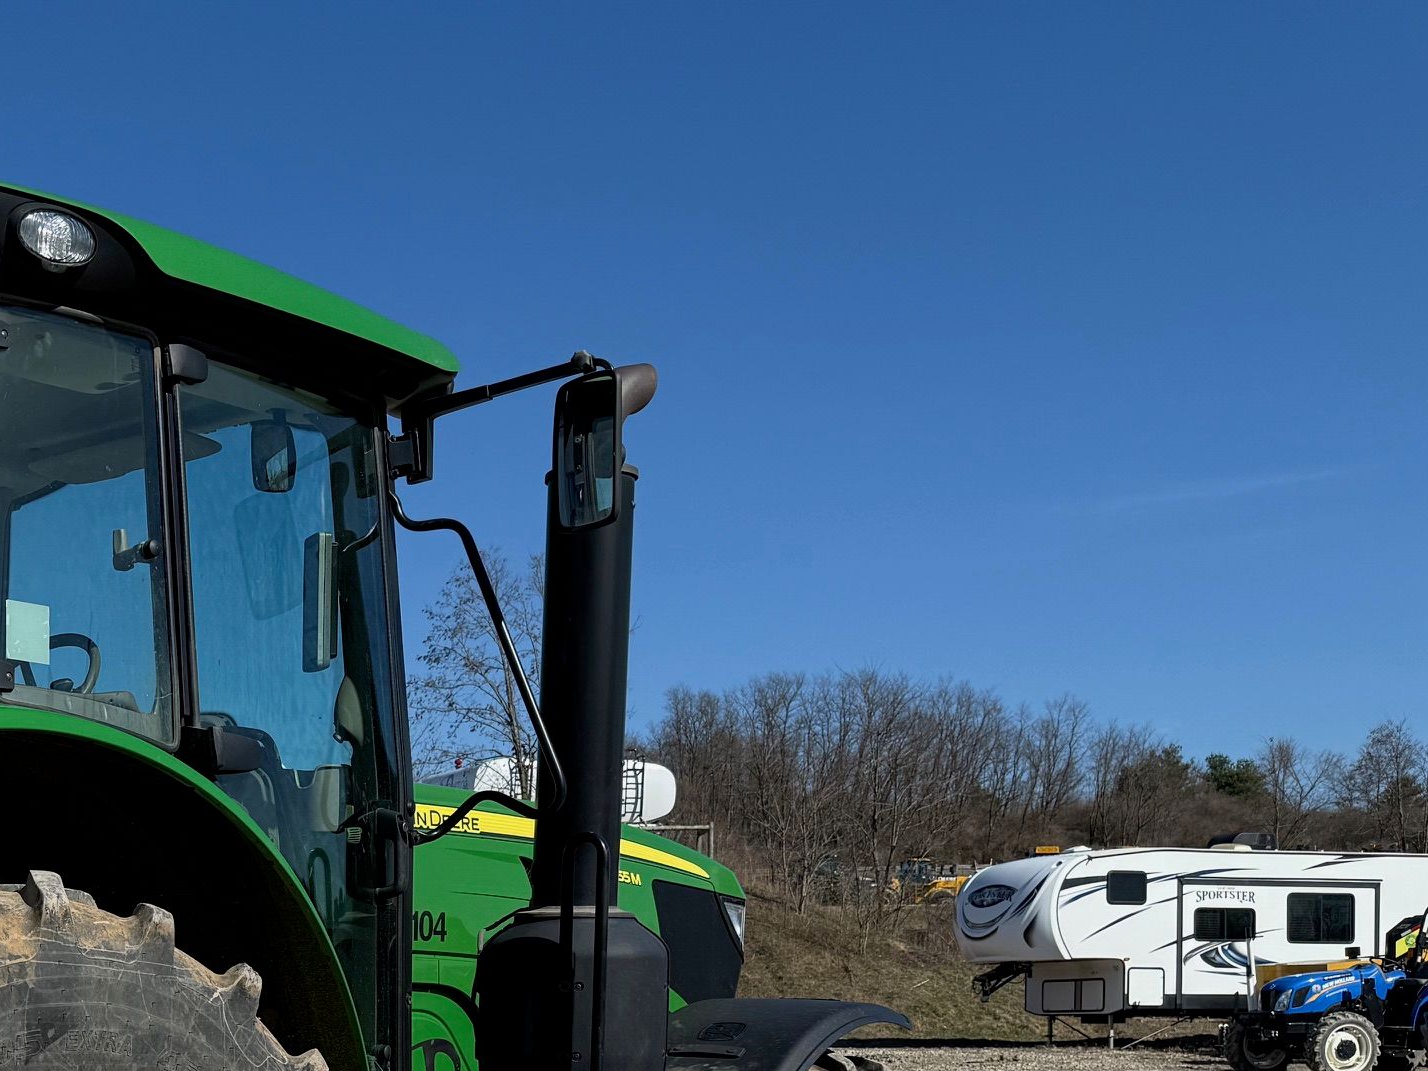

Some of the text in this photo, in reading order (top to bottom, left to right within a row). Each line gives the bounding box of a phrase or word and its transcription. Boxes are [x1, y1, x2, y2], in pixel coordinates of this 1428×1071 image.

[429, 809, 480, 831] DRE
[618, 870, 642, 886] 55M
[1195, 890, 1256, 903] SPORTSTER
[412, 910, 447, 942] 104
[63, 1029, 133, 1057] EXTRA
